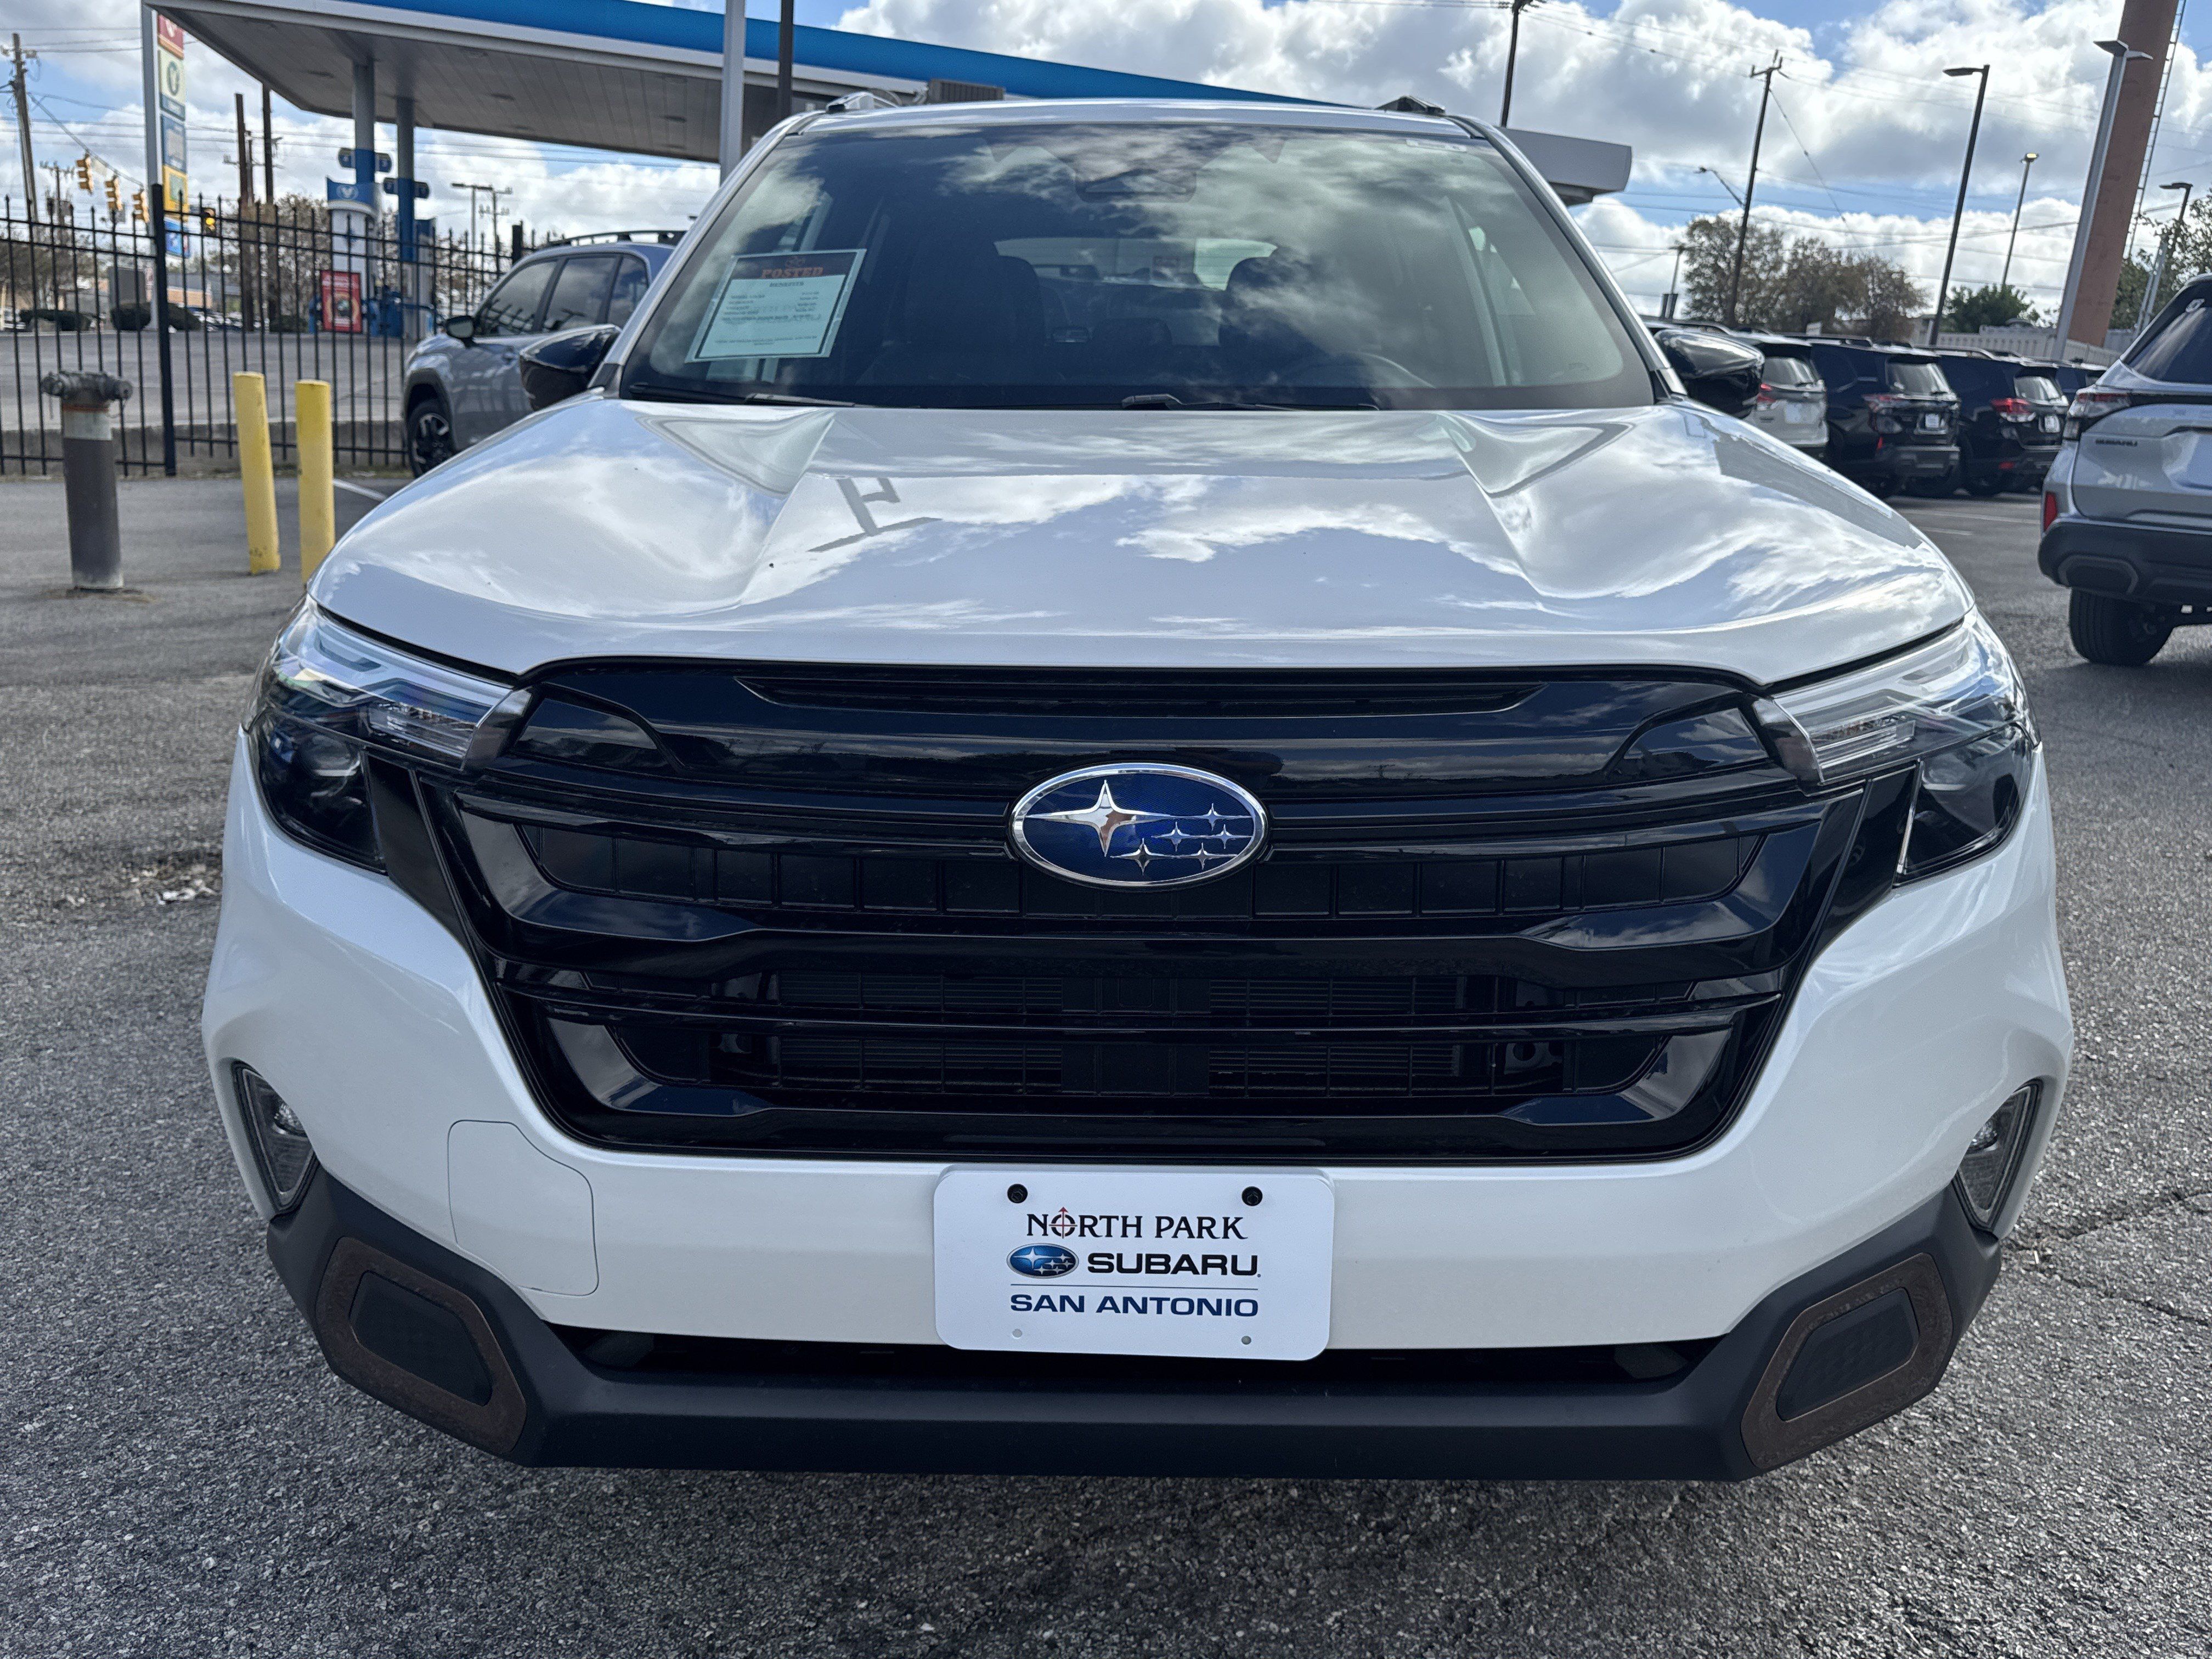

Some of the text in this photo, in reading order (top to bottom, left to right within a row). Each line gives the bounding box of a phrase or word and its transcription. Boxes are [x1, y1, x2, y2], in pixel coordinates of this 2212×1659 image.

[761, 267, 823, 279] POSTED
[1026, 1213, 1249, 1240] NORTH PARK
[1087, 1252, 1259, 1276] SUBARU
[1011, 1294, 1259, 1317] SAN ANTONIO
